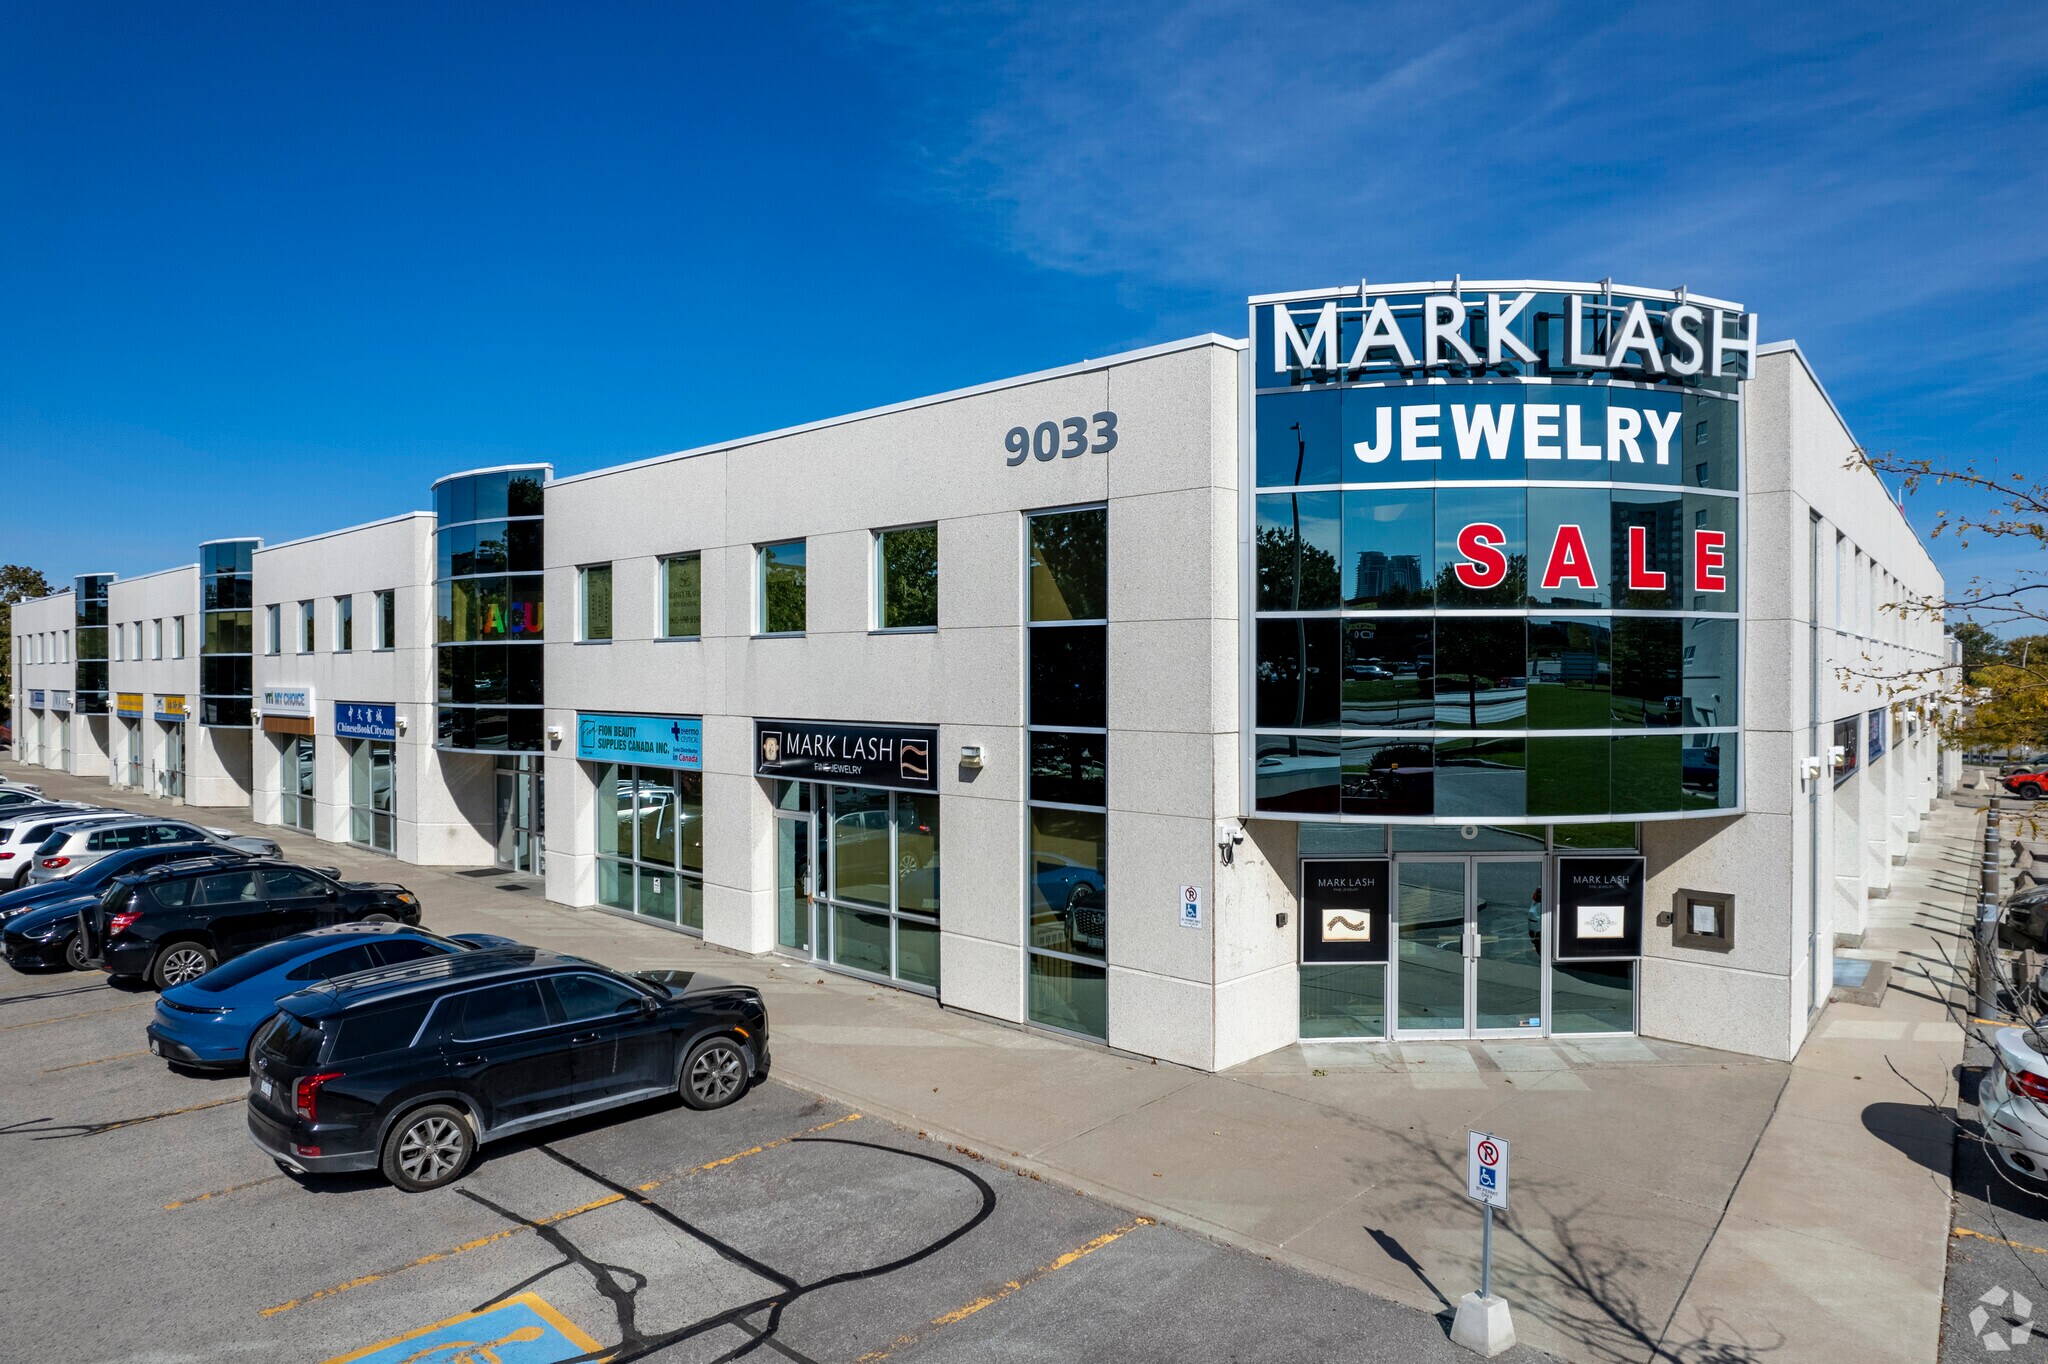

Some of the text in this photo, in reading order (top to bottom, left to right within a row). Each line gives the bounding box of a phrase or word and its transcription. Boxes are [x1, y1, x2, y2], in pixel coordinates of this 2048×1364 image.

[1274, 291, 1758, 381] MARK LASH
[1004, 410, 1119, 467] 9033
[1353, 403, 1683, 465] JEWELRY
[1454, 521, 1727, 593] SALE
[284, 692, 305, 707] CHOICE
[337, 721, 395, 738] ChineseBookCity.com
[598, 725, 637, 738] FION BEAUTY
[598, 738, 670, 754] SUPPLIES CANADA INC.
[786, 733, 894, 762] MARK LASH
[672, 752, 698, 763] in Canada
[831, 764, 862, 775] JEWELRY
[1318, 878, 1375, 887] MARK LASH
[1573, 875, 1630, 884] MARK LASH
